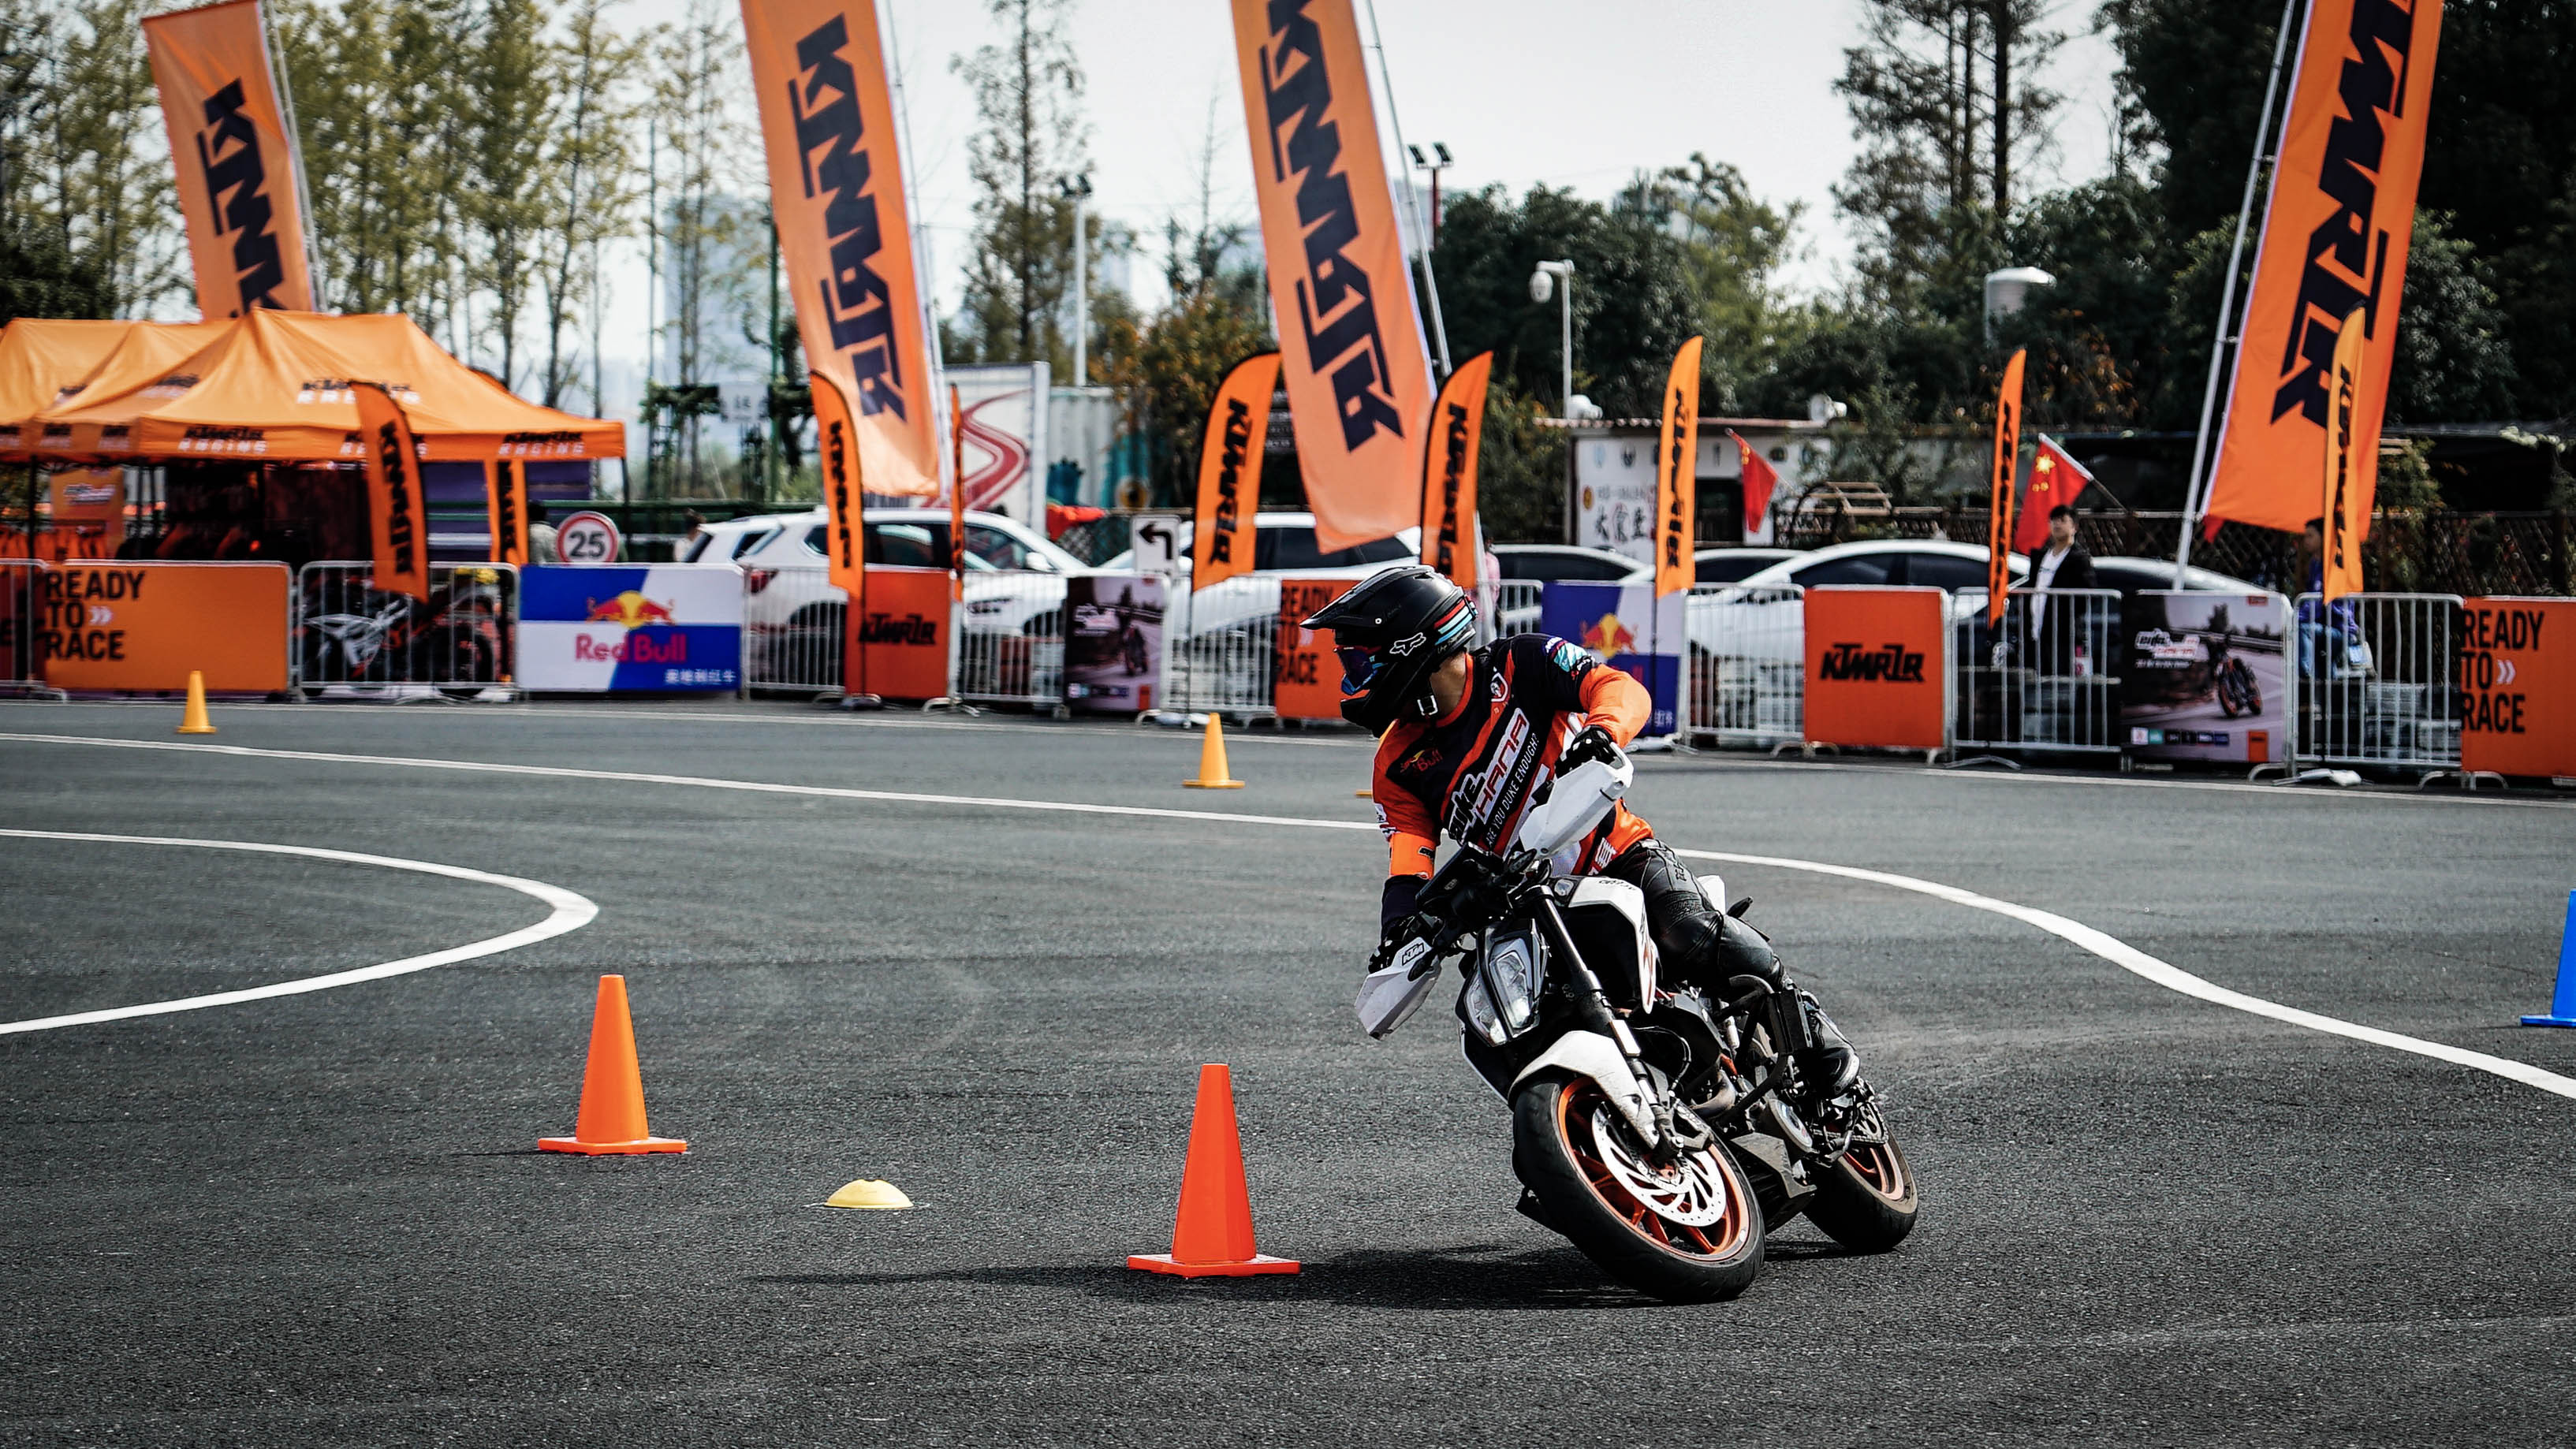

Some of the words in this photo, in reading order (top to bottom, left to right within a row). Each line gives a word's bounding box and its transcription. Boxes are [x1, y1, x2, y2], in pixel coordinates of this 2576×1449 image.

[569, 531, 606, 560] 25
[45, 570, 145, 599] READY
[47, 602, 84, 628] TO
[2462, 609, 2544, 651] READY
[45, 631, 125, 659] RACE
[576, 632, 628, 662] Red
[634, 634, 687, 662] Bull
[1278, 620, 1299, 650] TO
[1277, 654, 1318, 684] RACE
[2462, 651, 2492, 690] TO
[2461, 693, 2526, 734] RACE
[1486, 828, 1497, 846] ARE
[1492, 810, 1507, 829] YOU
[1503, 780, 1520, 810] DUKE
[1515, 732, 1540, 783] ENOUGH?
[1402, 943, 1425, 967] KTM
